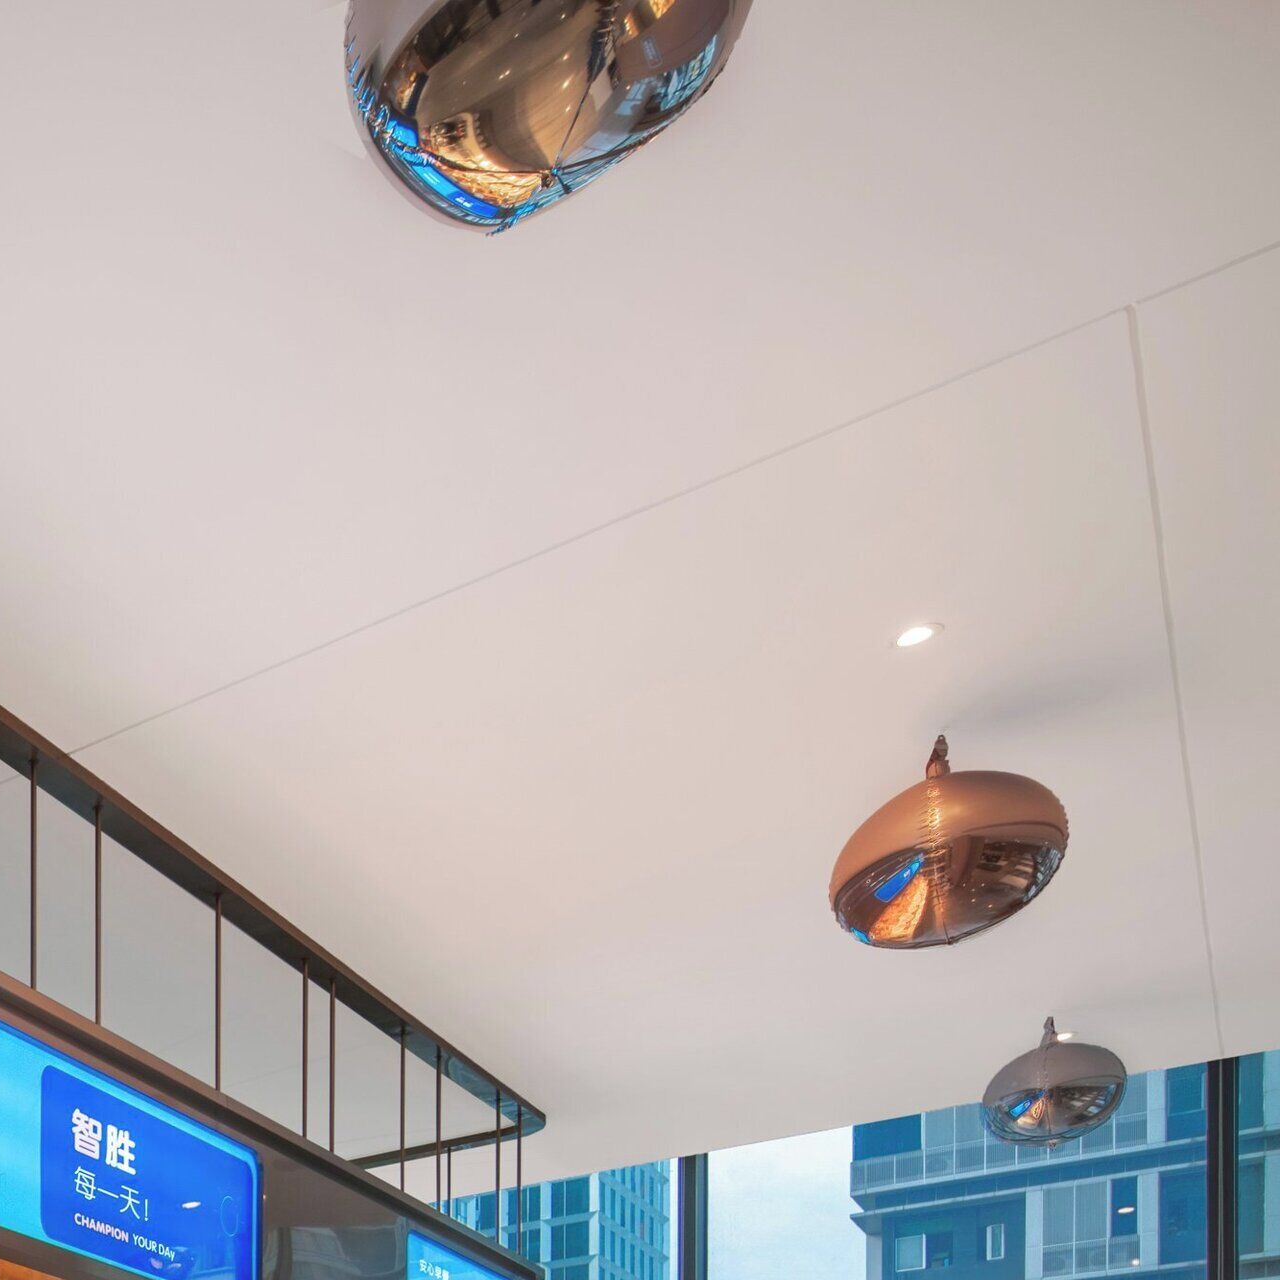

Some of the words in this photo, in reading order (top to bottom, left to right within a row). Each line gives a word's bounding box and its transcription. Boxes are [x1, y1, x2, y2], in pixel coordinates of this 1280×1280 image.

[71, 1108, 137, 1176] 智胜
[74, 1166, 149, 1222] 每一天！
[74, 1212, 130, 1243] CHAMPION
[132, 1233, 158, 1253] YOUR
